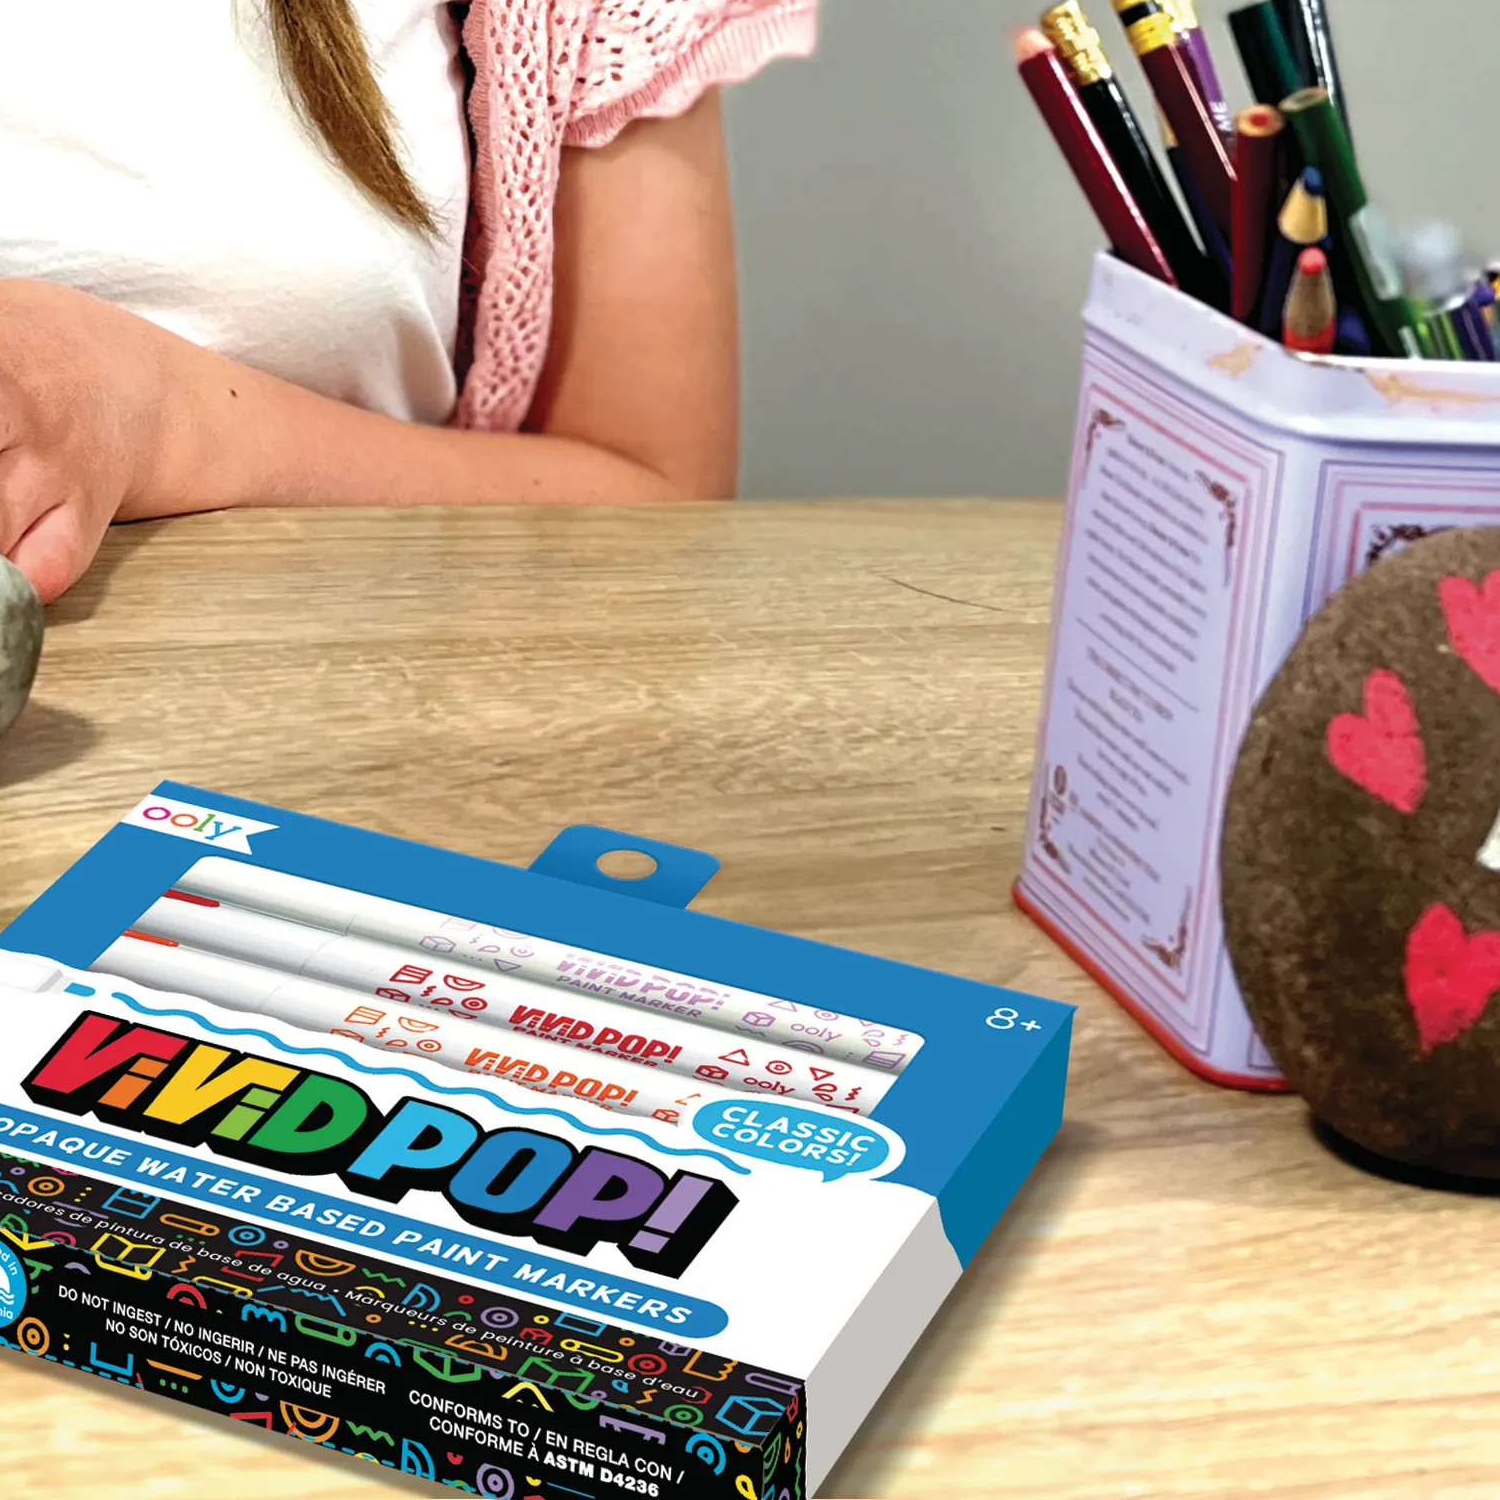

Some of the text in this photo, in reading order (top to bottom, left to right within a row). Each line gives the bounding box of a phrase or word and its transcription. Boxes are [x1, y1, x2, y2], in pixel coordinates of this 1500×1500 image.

[143, 806, 242, 840] ooly
[556, 975, 703, 1019] PAINT MARKER
[790, 1021, 842, 1043] ooly
[985, 1007, 1042, 1032] 8+
[512, 1025, 658, 1067] PAINT MARKER
[592, 1027, 683, 1064] POP!
[548, 1070, 639, 1107] POP!
[743, 1075, 796, 1096] ooly
[712, 1123, 862, 1167] COLORS!
[722, 1106, 876, 1153] CLASSIC
[346, 1097, 722, 1264] POP!
[137, 1157, 262, 1203] WATER
[265, 1195, 386, 1237] BASED
[392, 1230, 509, 1271] PAINT
[512, 1263, 693, 1324] MARKERS
[69, 1209, 93, 1223] de
[91, 1219, 165, 1245] pintura
[169, 1238, 193, 1252] de
[197, 1247, 243, 1268] base
[248, 1261, 272, 1275] de
[277, 1270, 327, 1292] agua
[345, 1290, 448, 1326] Marqueurs
[452, 1321, 477, 1335] de
[480, 1330, 564, 1360] peinture
[587, 1360, 636, 1381] base
[58, 1285, 78, 1302] DO
[81, 1291, 110, 1312] NOT
[112, 1300, 162, 1327] INGEST
[174, 1319, 194, 1337] NO
[197, 1325, 256, 1355] INGERIR
[267, 1348, 288, 1365] NE
[290, 1355, 318, 1375] PAS
[321, 1363, 386, 1395] INGÉRER
[105, 1318, 126, 1336] NO
[128, 1323, 159, 1344] SON
[161, 1331, 222, 1367] TÓXICOS
[234, 1356, 266, 1378] NON
[268, 1367, 332, 1399] TOXIQUE
[409, 1389, 503, 1430] CONFORMS
[507, 1418, 530, 1438] TO
[545, 1430, 569, 1449] EN
[573, 1438, 630, 1469] REGLA
[634, 1456, 673, 1481] CON
[429, 1416, 660, 1498] CONFORME À ASTM D4236
